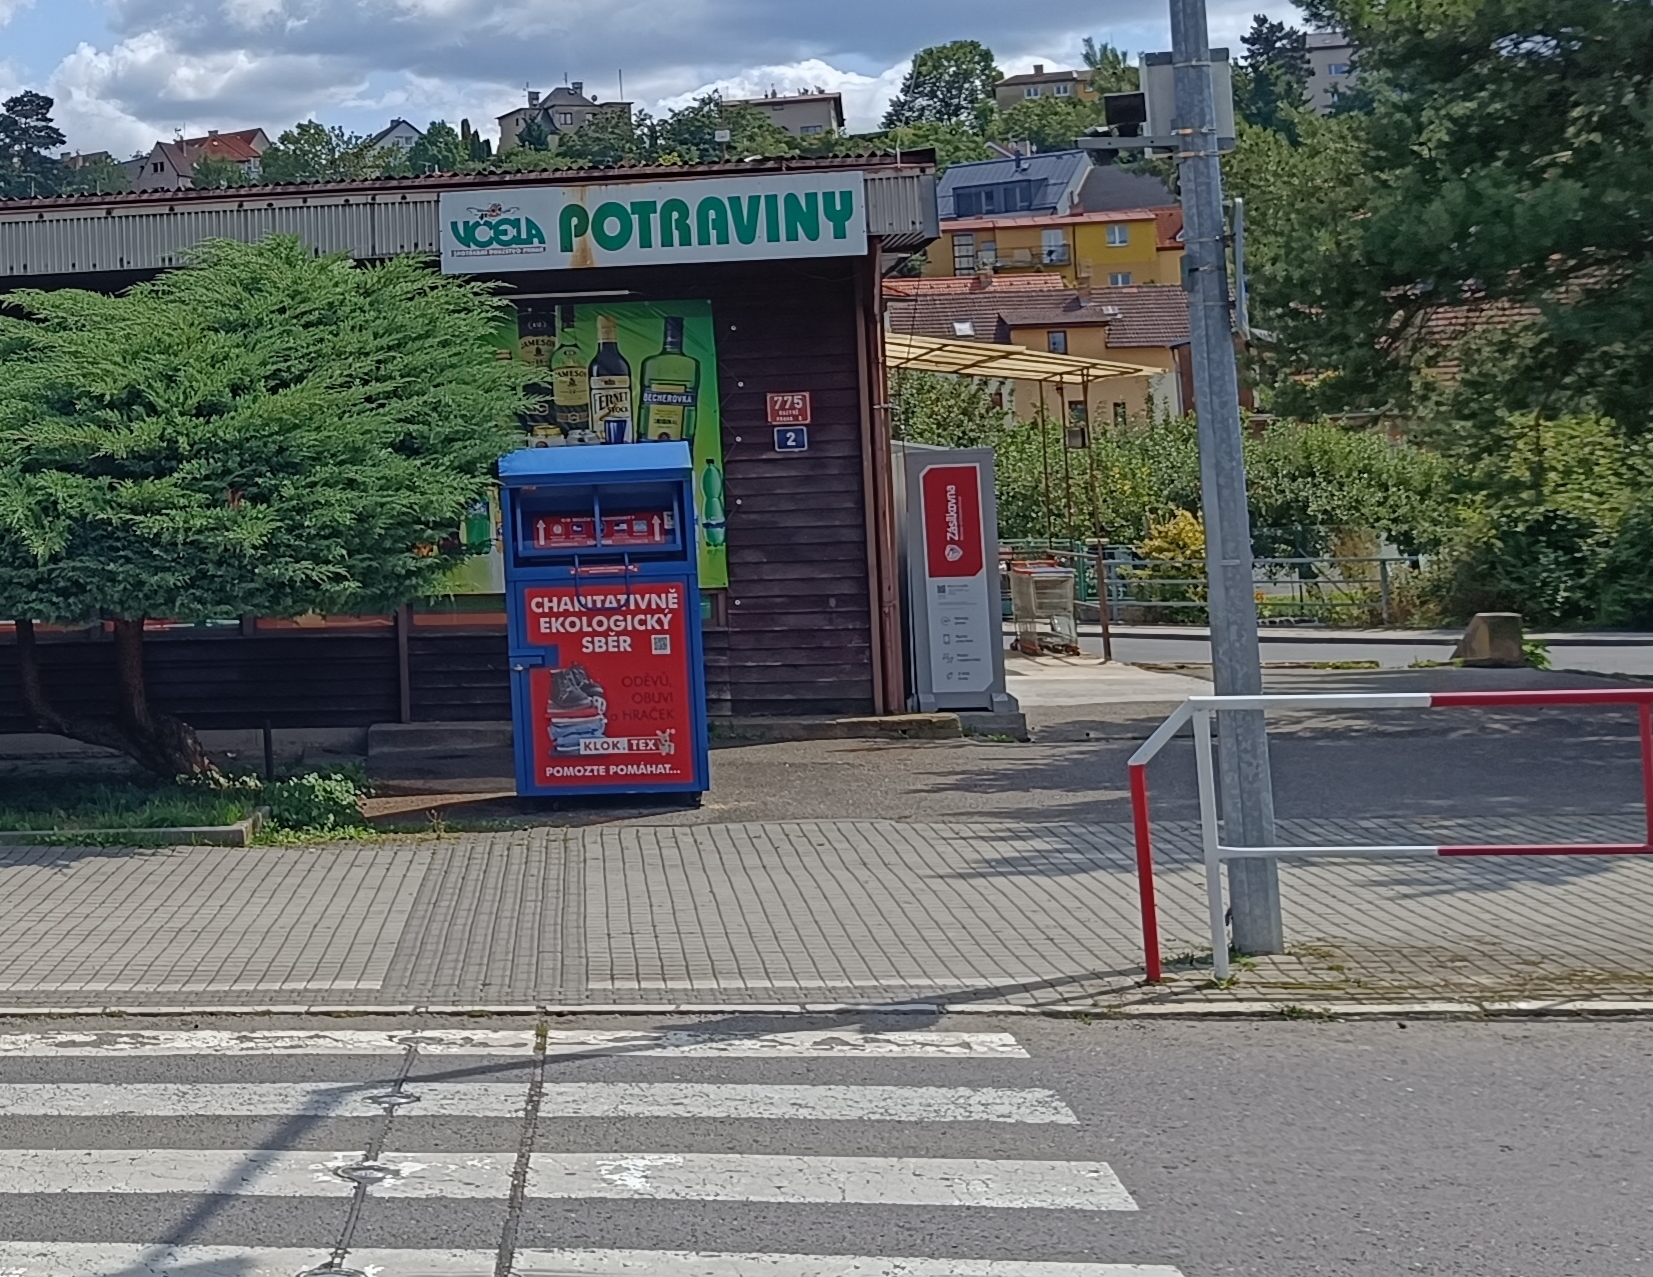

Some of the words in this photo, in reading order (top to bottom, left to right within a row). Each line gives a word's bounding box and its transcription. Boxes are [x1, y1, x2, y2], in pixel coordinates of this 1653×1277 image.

[559, 190, 854, 253] POTRAVINY
[521, 338, 556, 350] JAMESON
[593, 392, 628, 414] FERNET
[643, 391, 693, 404] BECHEROVKA
[774, 396, 803, 409] 775
[785, 431, 796, 446] 2
[945, 484, 959, 541] Zásilkovna
[531, 588, 679, 613] CHARITATIVNĚ
[539, 609, 673, 633] EKOLOGICKÝ
[581, 631, 632, 653] SBĚR
[632, 692, 674, 704] OBUVI
[623, 708, 675, 722] HRAČEK
[546, 765, 606, 777] POMOZTE
[609, 761, 681, 776] POMÁHAT...
